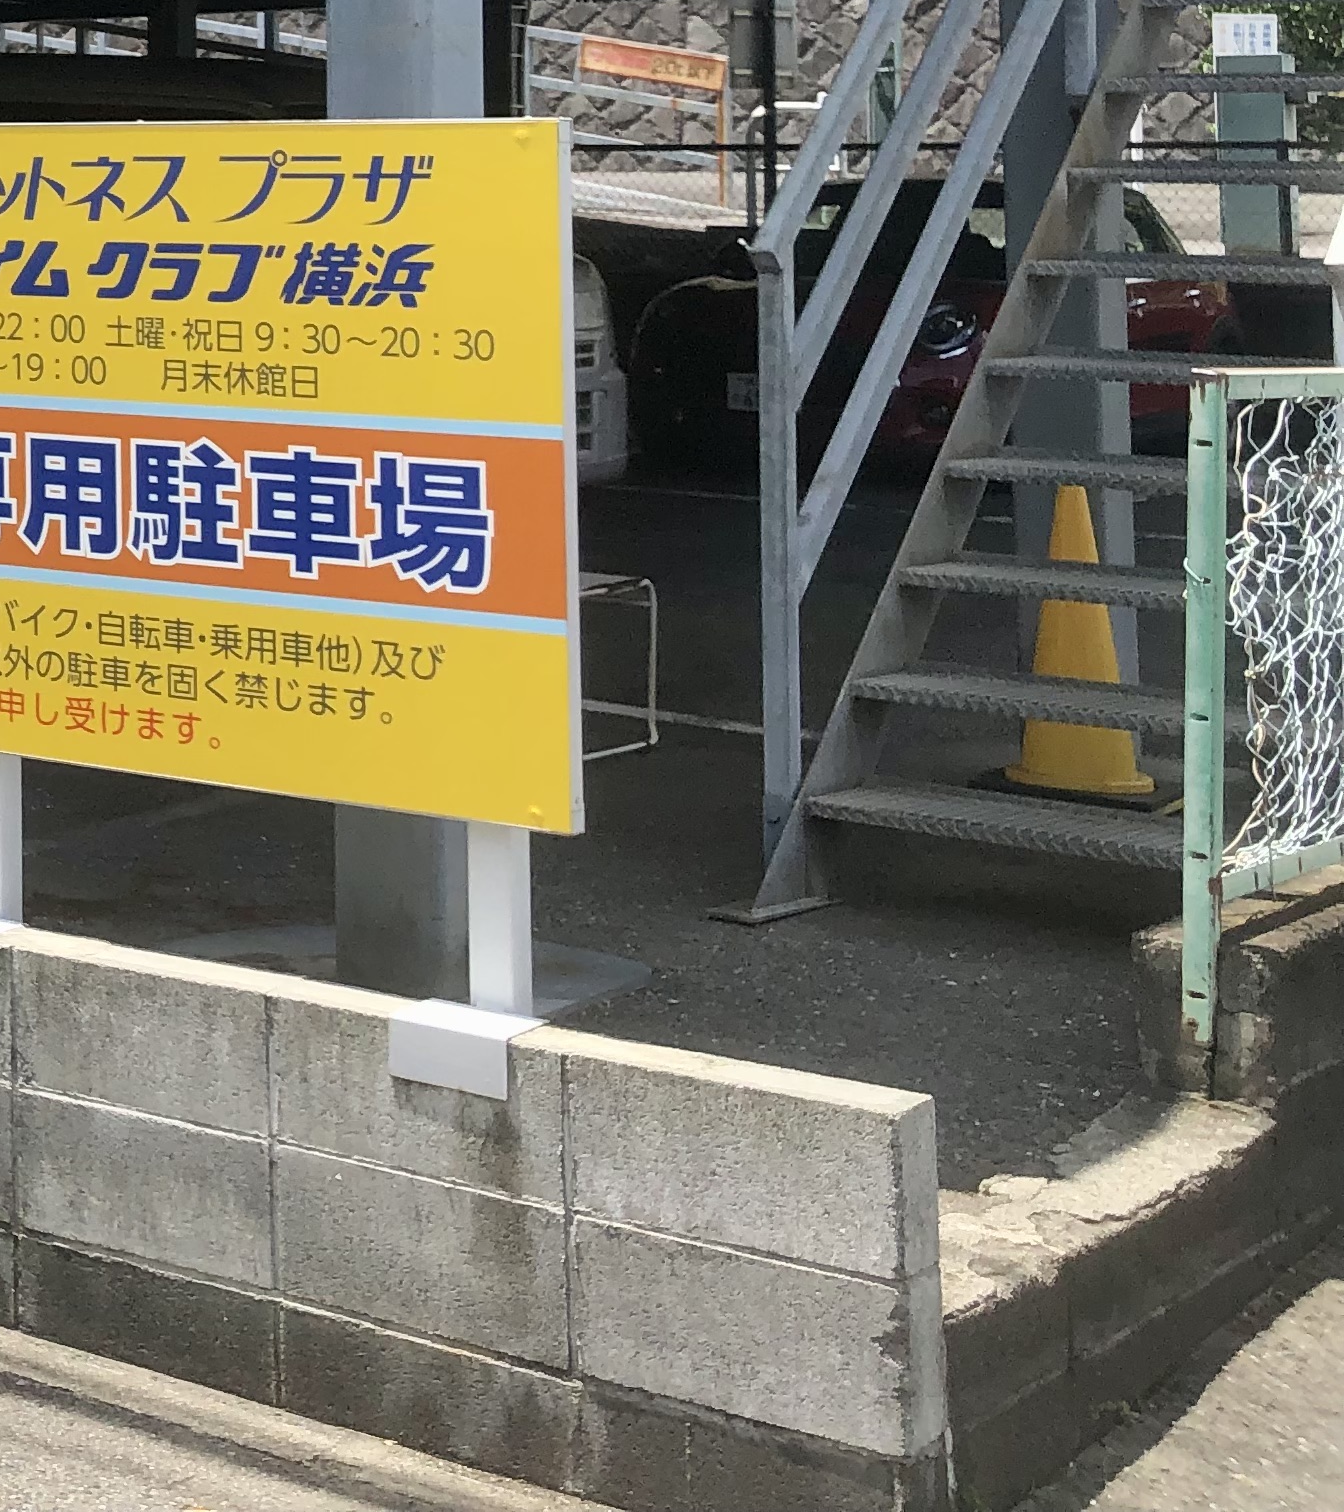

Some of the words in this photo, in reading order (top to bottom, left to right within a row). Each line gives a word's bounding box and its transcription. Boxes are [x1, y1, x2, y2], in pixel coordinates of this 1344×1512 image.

[215, 149, 435, 226] プラザ
[160, 359, 319, 399] 月末休館日
